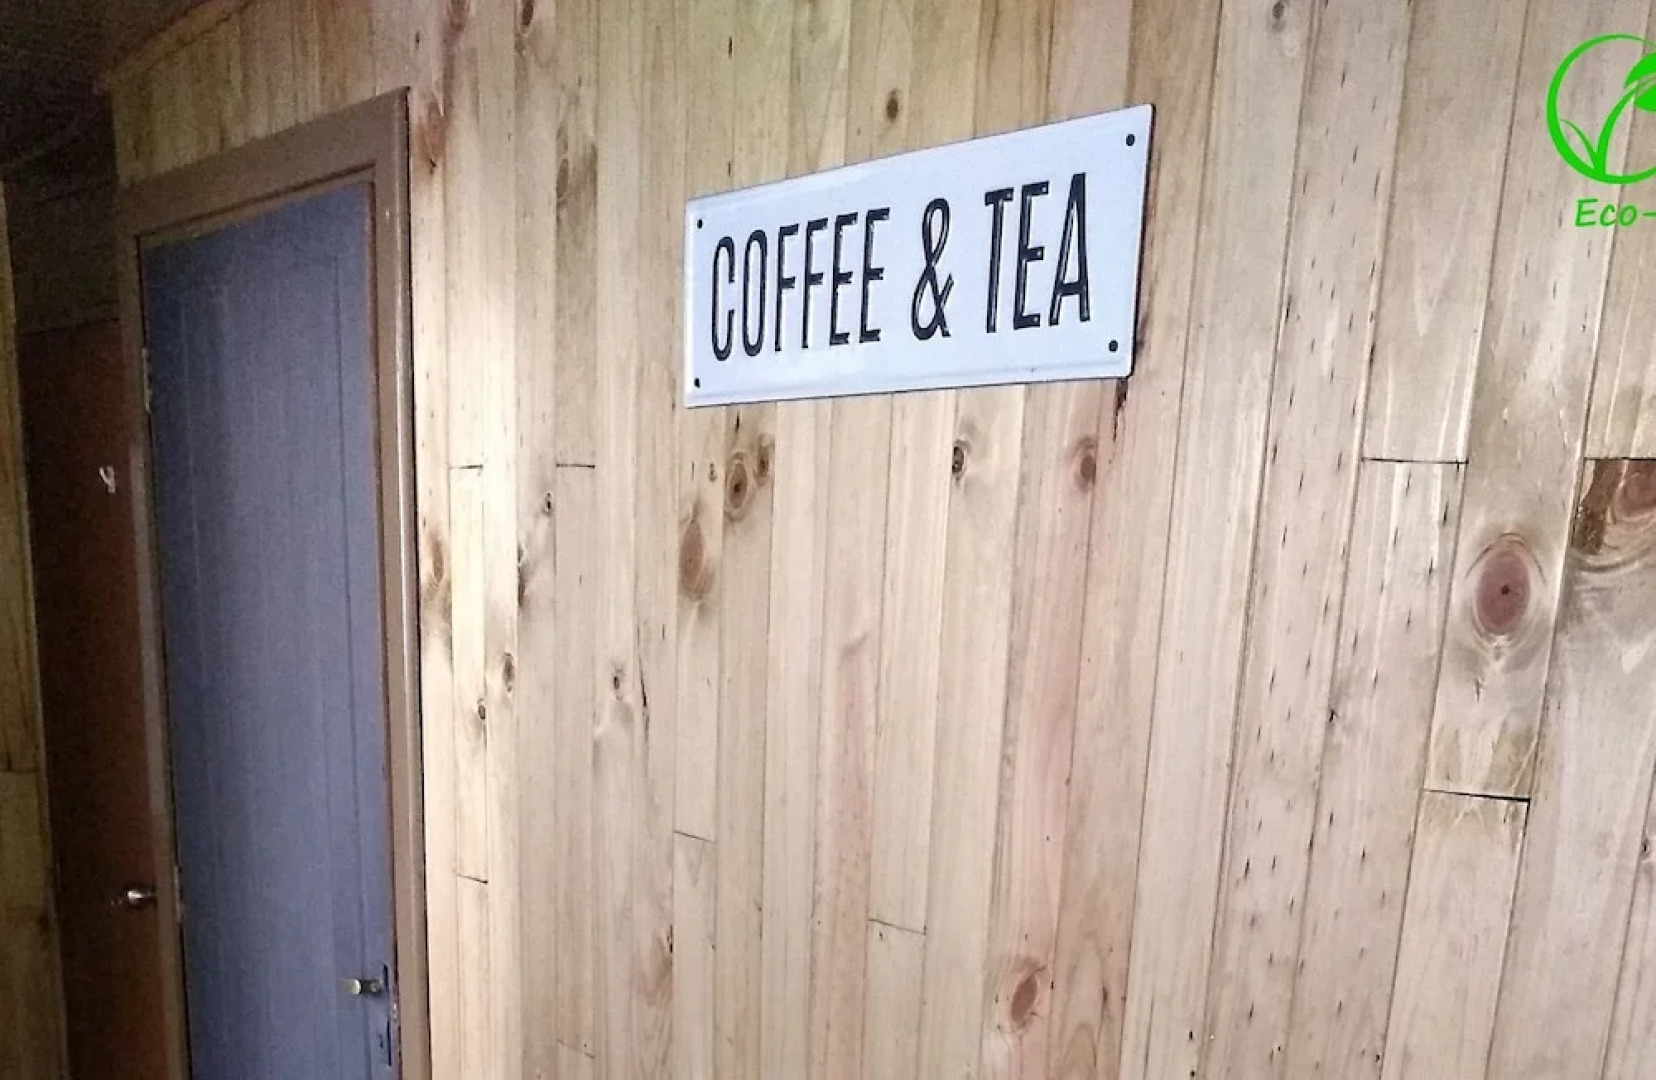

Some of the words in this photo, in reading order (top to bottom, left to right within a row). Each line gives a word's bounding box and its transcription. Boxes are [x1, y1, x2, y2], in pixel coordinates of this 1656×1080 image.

[711, 206, 890, 362] COFFEE
[911, 197, 954, 342] &
[984, 171, 1091, 334] TEA
